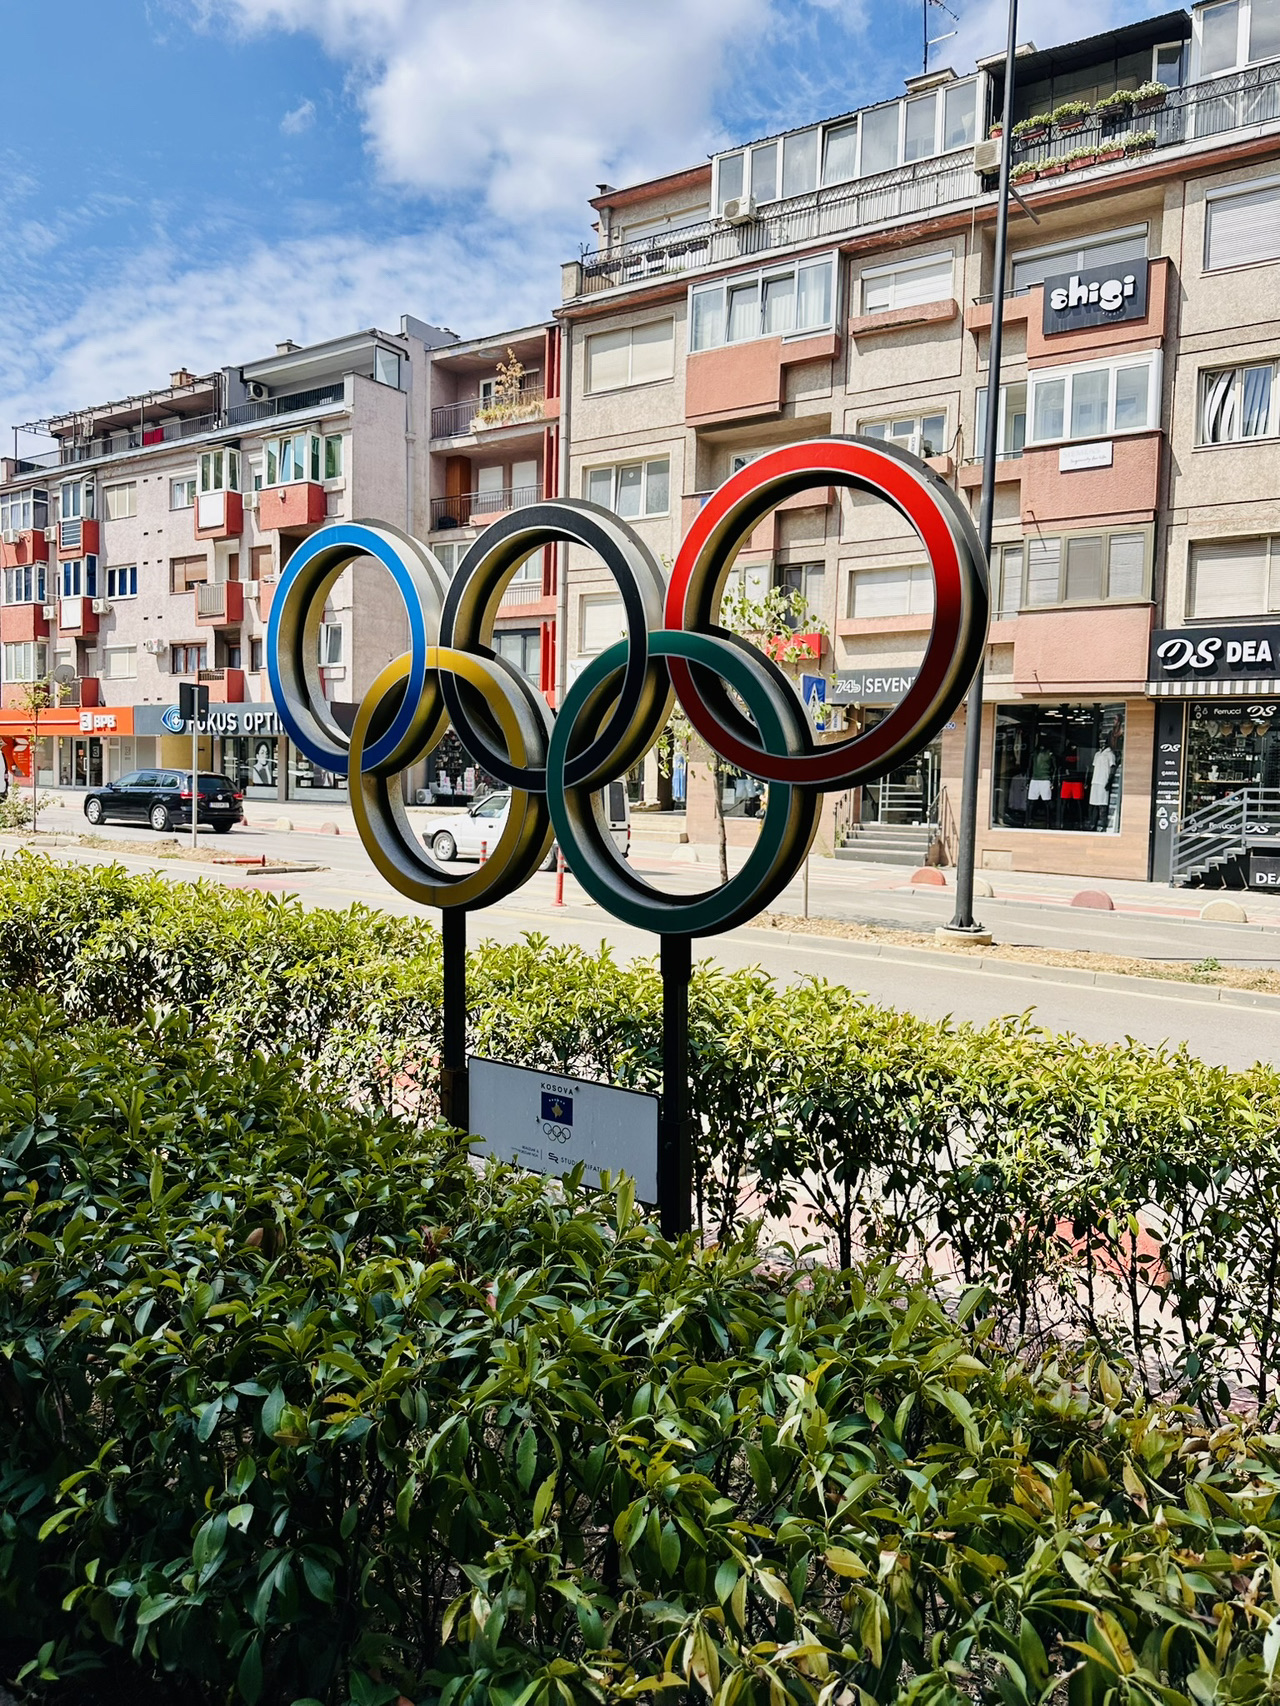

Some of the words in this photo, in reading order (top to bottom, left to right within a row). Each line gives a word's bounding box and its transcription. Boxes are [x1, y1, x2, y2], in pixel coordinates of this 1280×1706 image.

[1050, 274, 1135, 311] shigi
[1156, 637, 1222, 670] DS
[1226, 640, 1273, 663] DEA
[865, 676, 915, 693] SEVEN
[93, 714, 116, 729] BPB
[243, 711, 283, 731] OPTI
[1255, 872, 1280, 885] DE
[541, 1082, 574, 1096] KOSOVA
[560, 1156, 577, 1166] STUD
